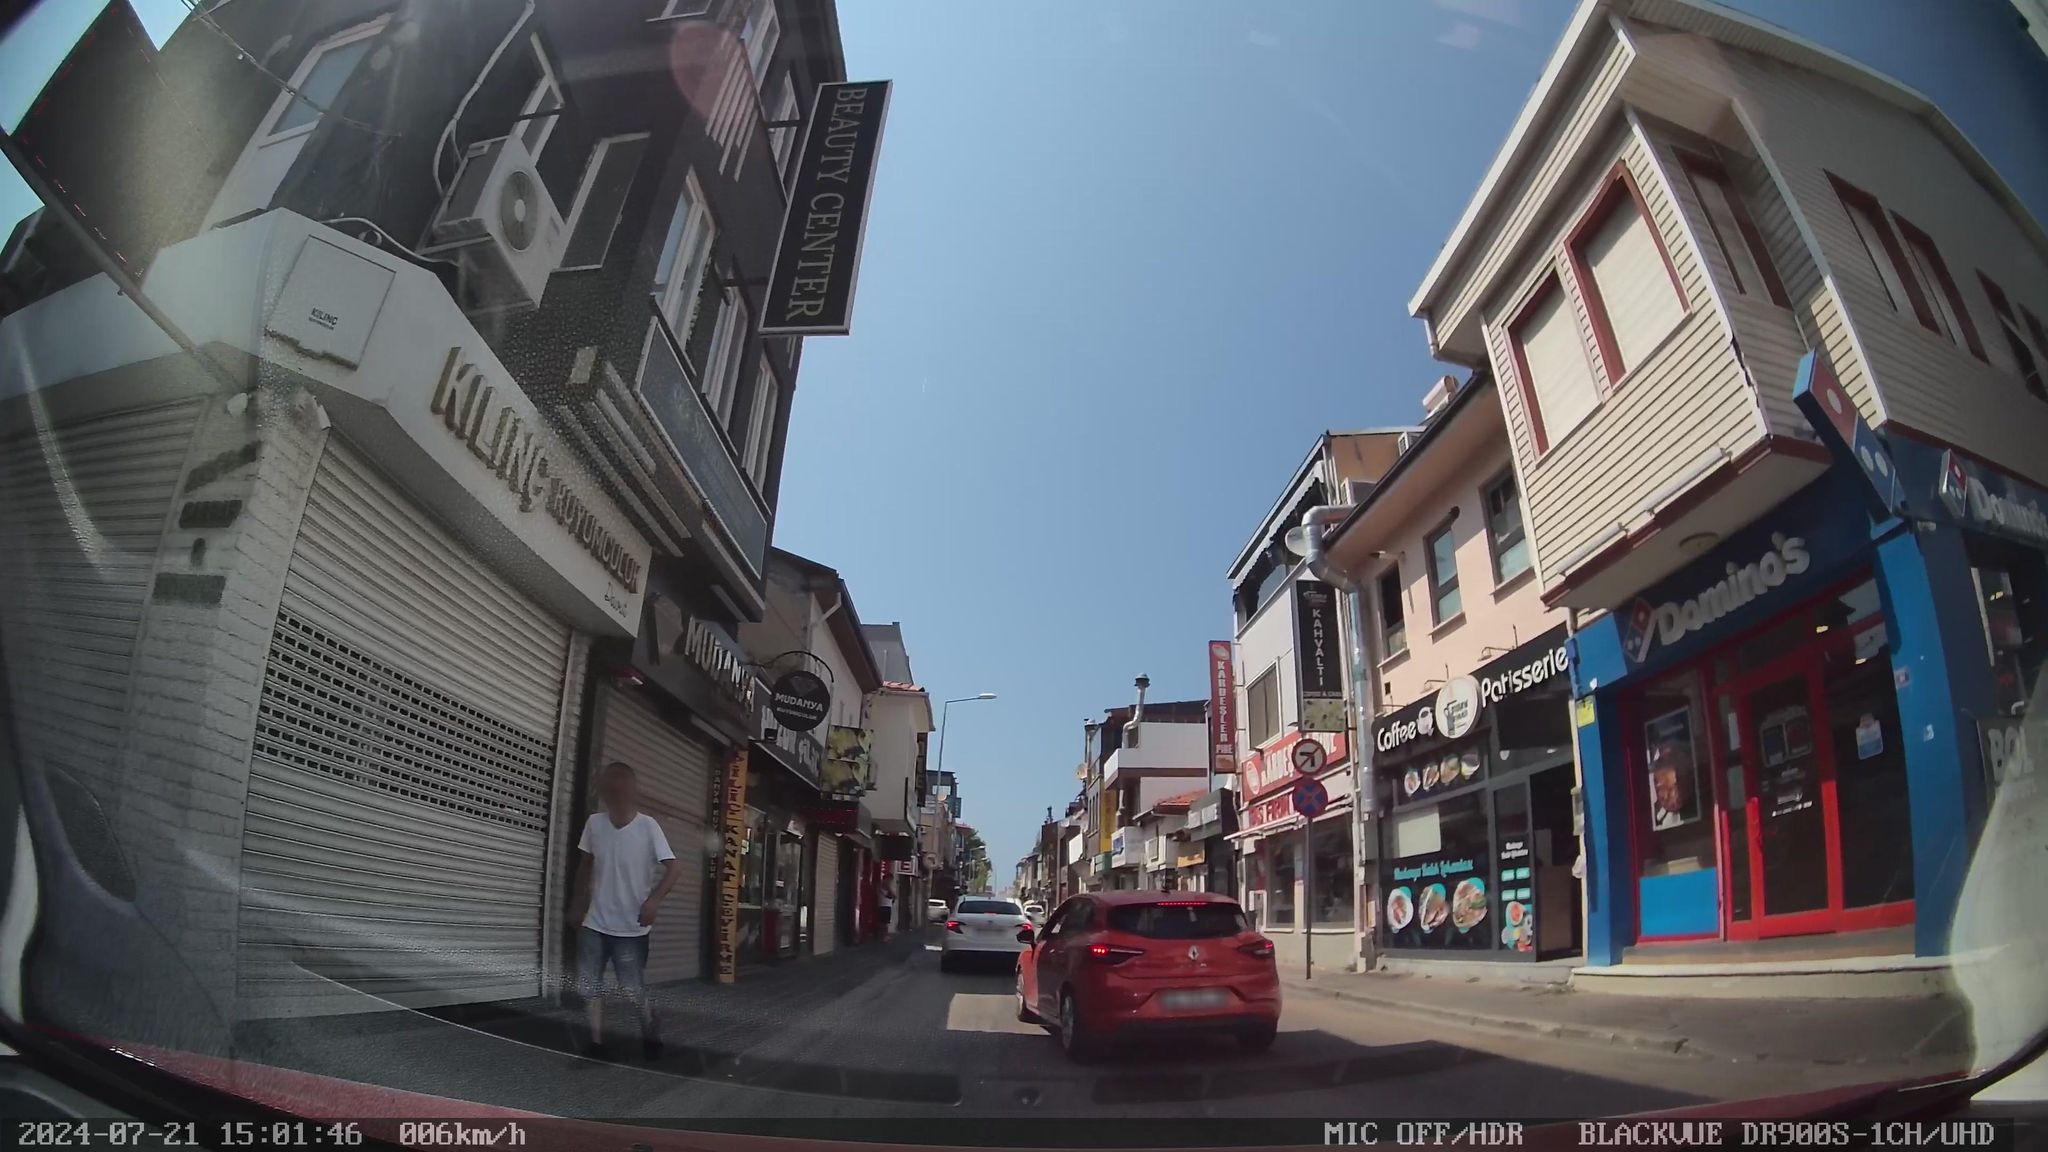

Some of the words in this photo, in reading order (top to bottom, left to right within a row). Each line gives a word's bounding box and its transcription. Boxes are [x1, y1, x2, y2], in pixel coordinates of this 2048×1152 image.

[816, 87, 868, 184] BEAUTY
[786, 192, 846, 321] CENTER
[1657, 531, 1811, 646] Domino's
[1312, 608, 1325, 686] KAHVALTI
[775, 692, 824, 712] MUDANYA
[1376, 719, 1417, 752] Coffee
[1481, 645, 1569, 708] Patisserie
